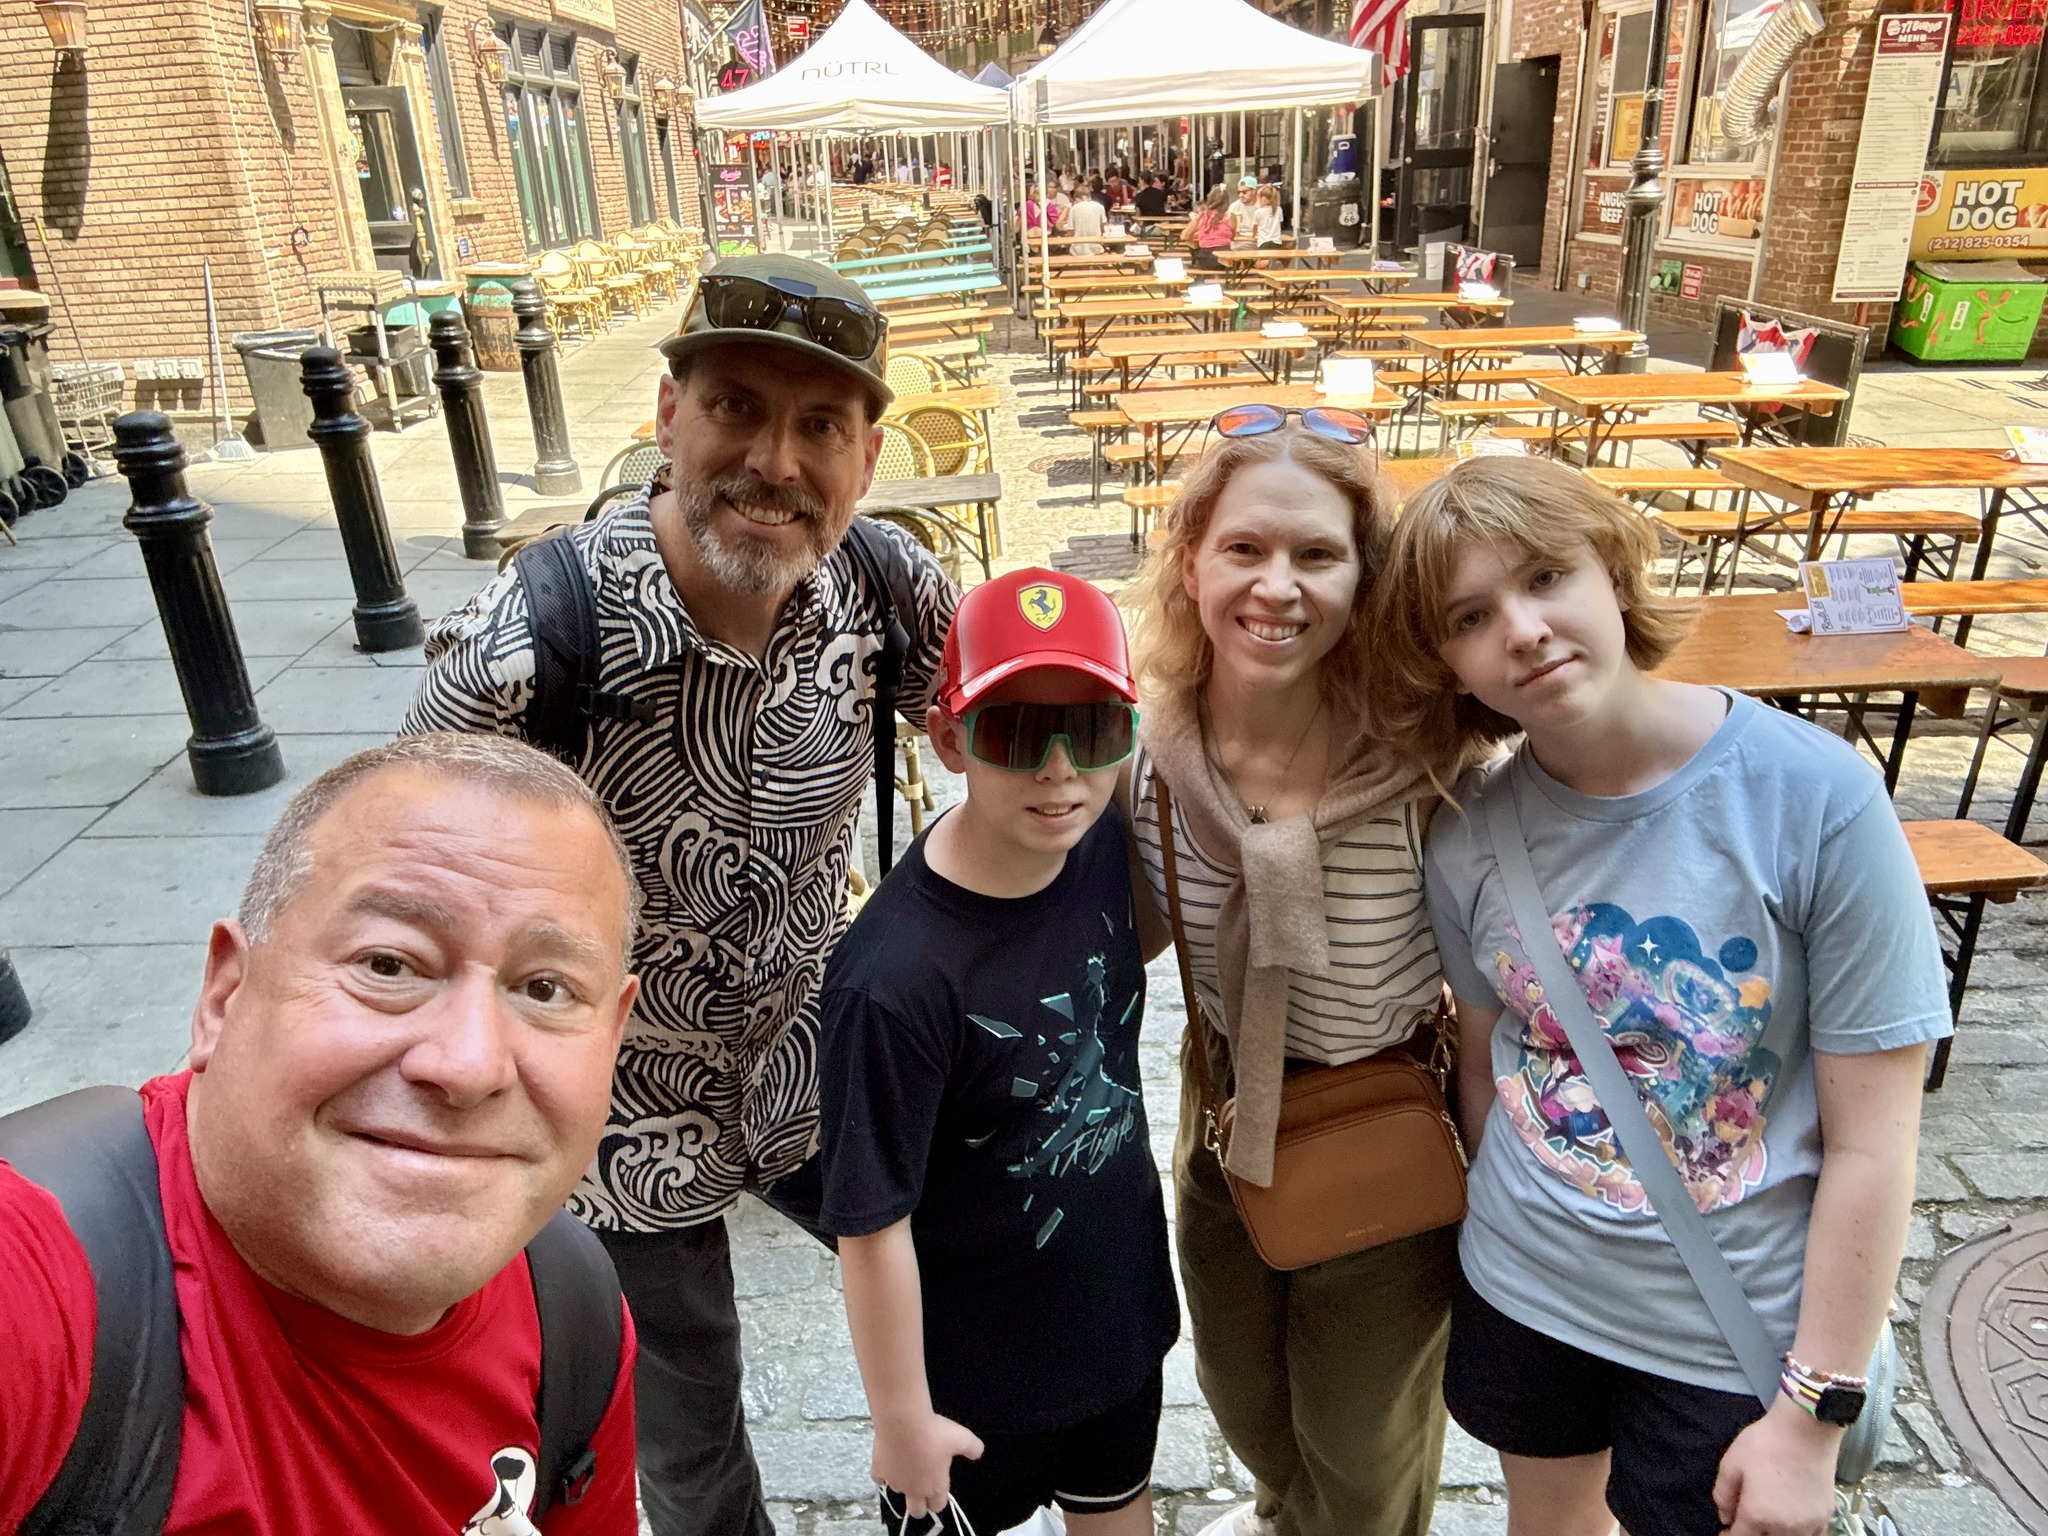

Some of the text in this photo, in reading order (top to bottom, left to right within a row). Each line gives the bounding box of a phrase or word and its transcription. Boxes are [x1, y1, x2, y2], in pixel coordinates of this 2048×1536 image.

[721, 68, 749, 91] 47
[1693, 190, 1722, 212] HOT
[1954, 180, 2025, 206] HOT
[1343, 215, 1356, 224] 66
[1600, 207, 1623, 224] BEEF
[1690, 211, 1719, 234] DOG
[1948, 205, 2019, 231] DOG
[1928, 235, 2030, 252] (212)825-0354
